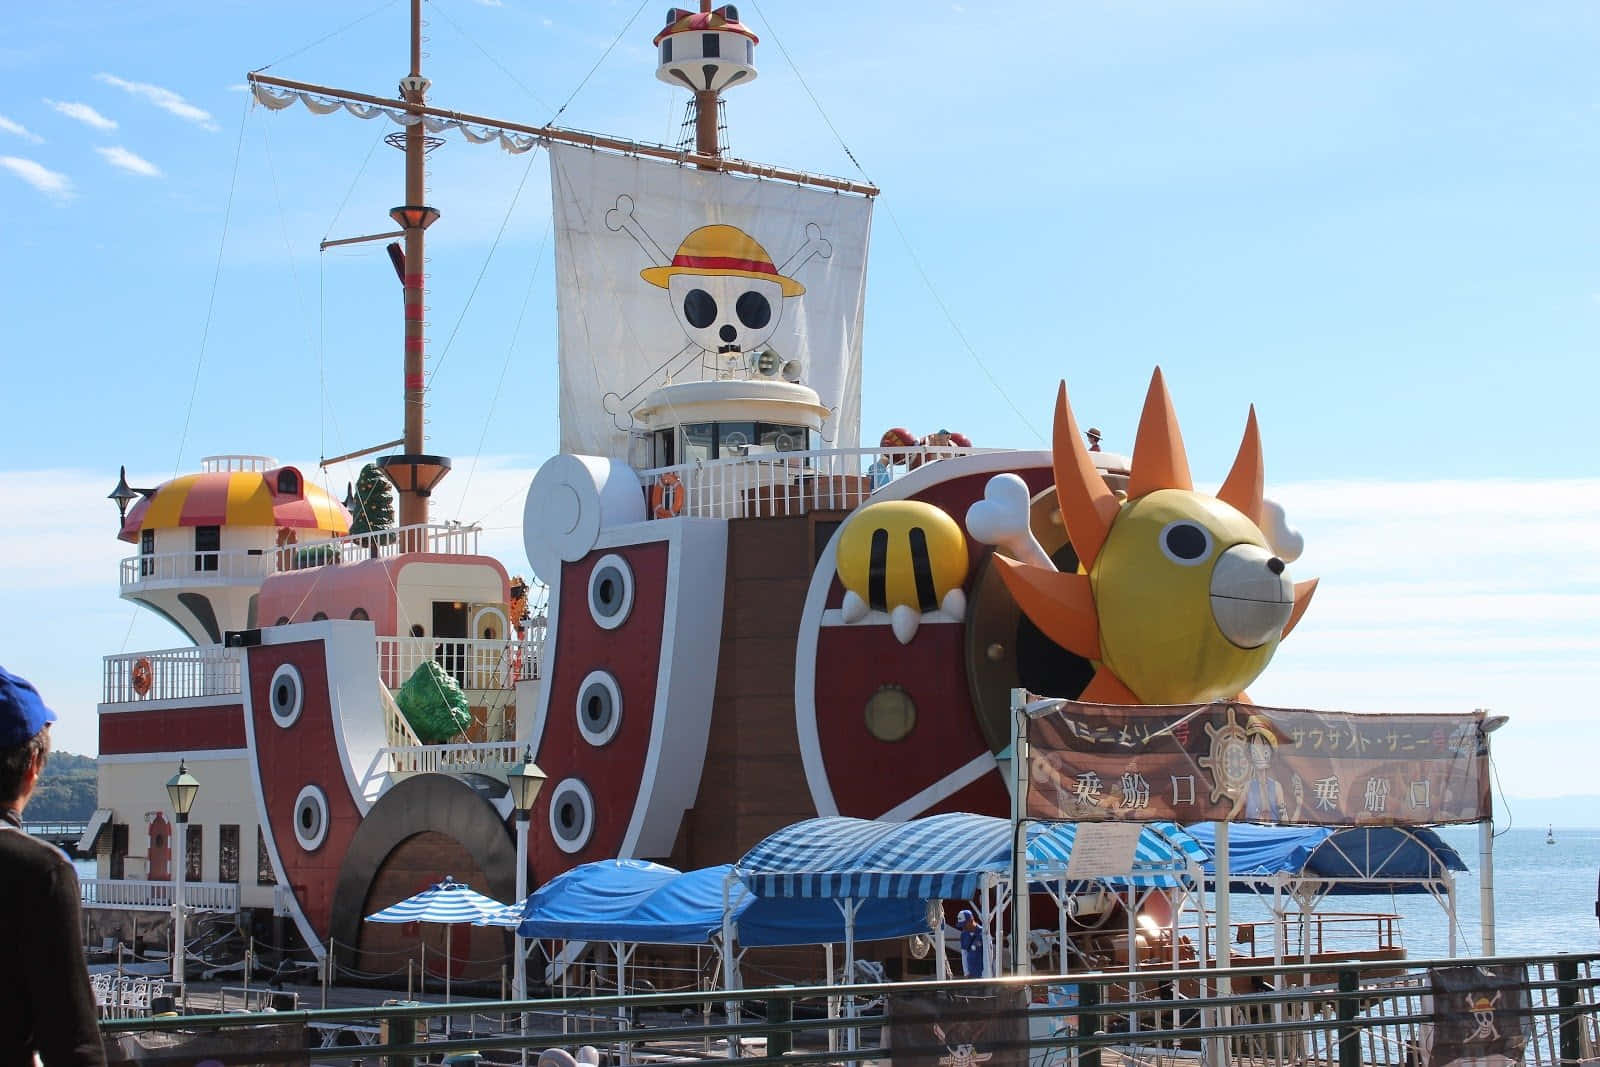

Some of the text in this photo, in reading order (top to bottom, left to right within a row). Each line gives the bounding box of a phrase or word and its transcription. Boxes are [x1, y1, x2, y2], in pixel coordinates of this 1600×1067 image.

[1072, 771, 1195, 809] 乗船口
[1313, 776, 1431, 812] 乗船口
